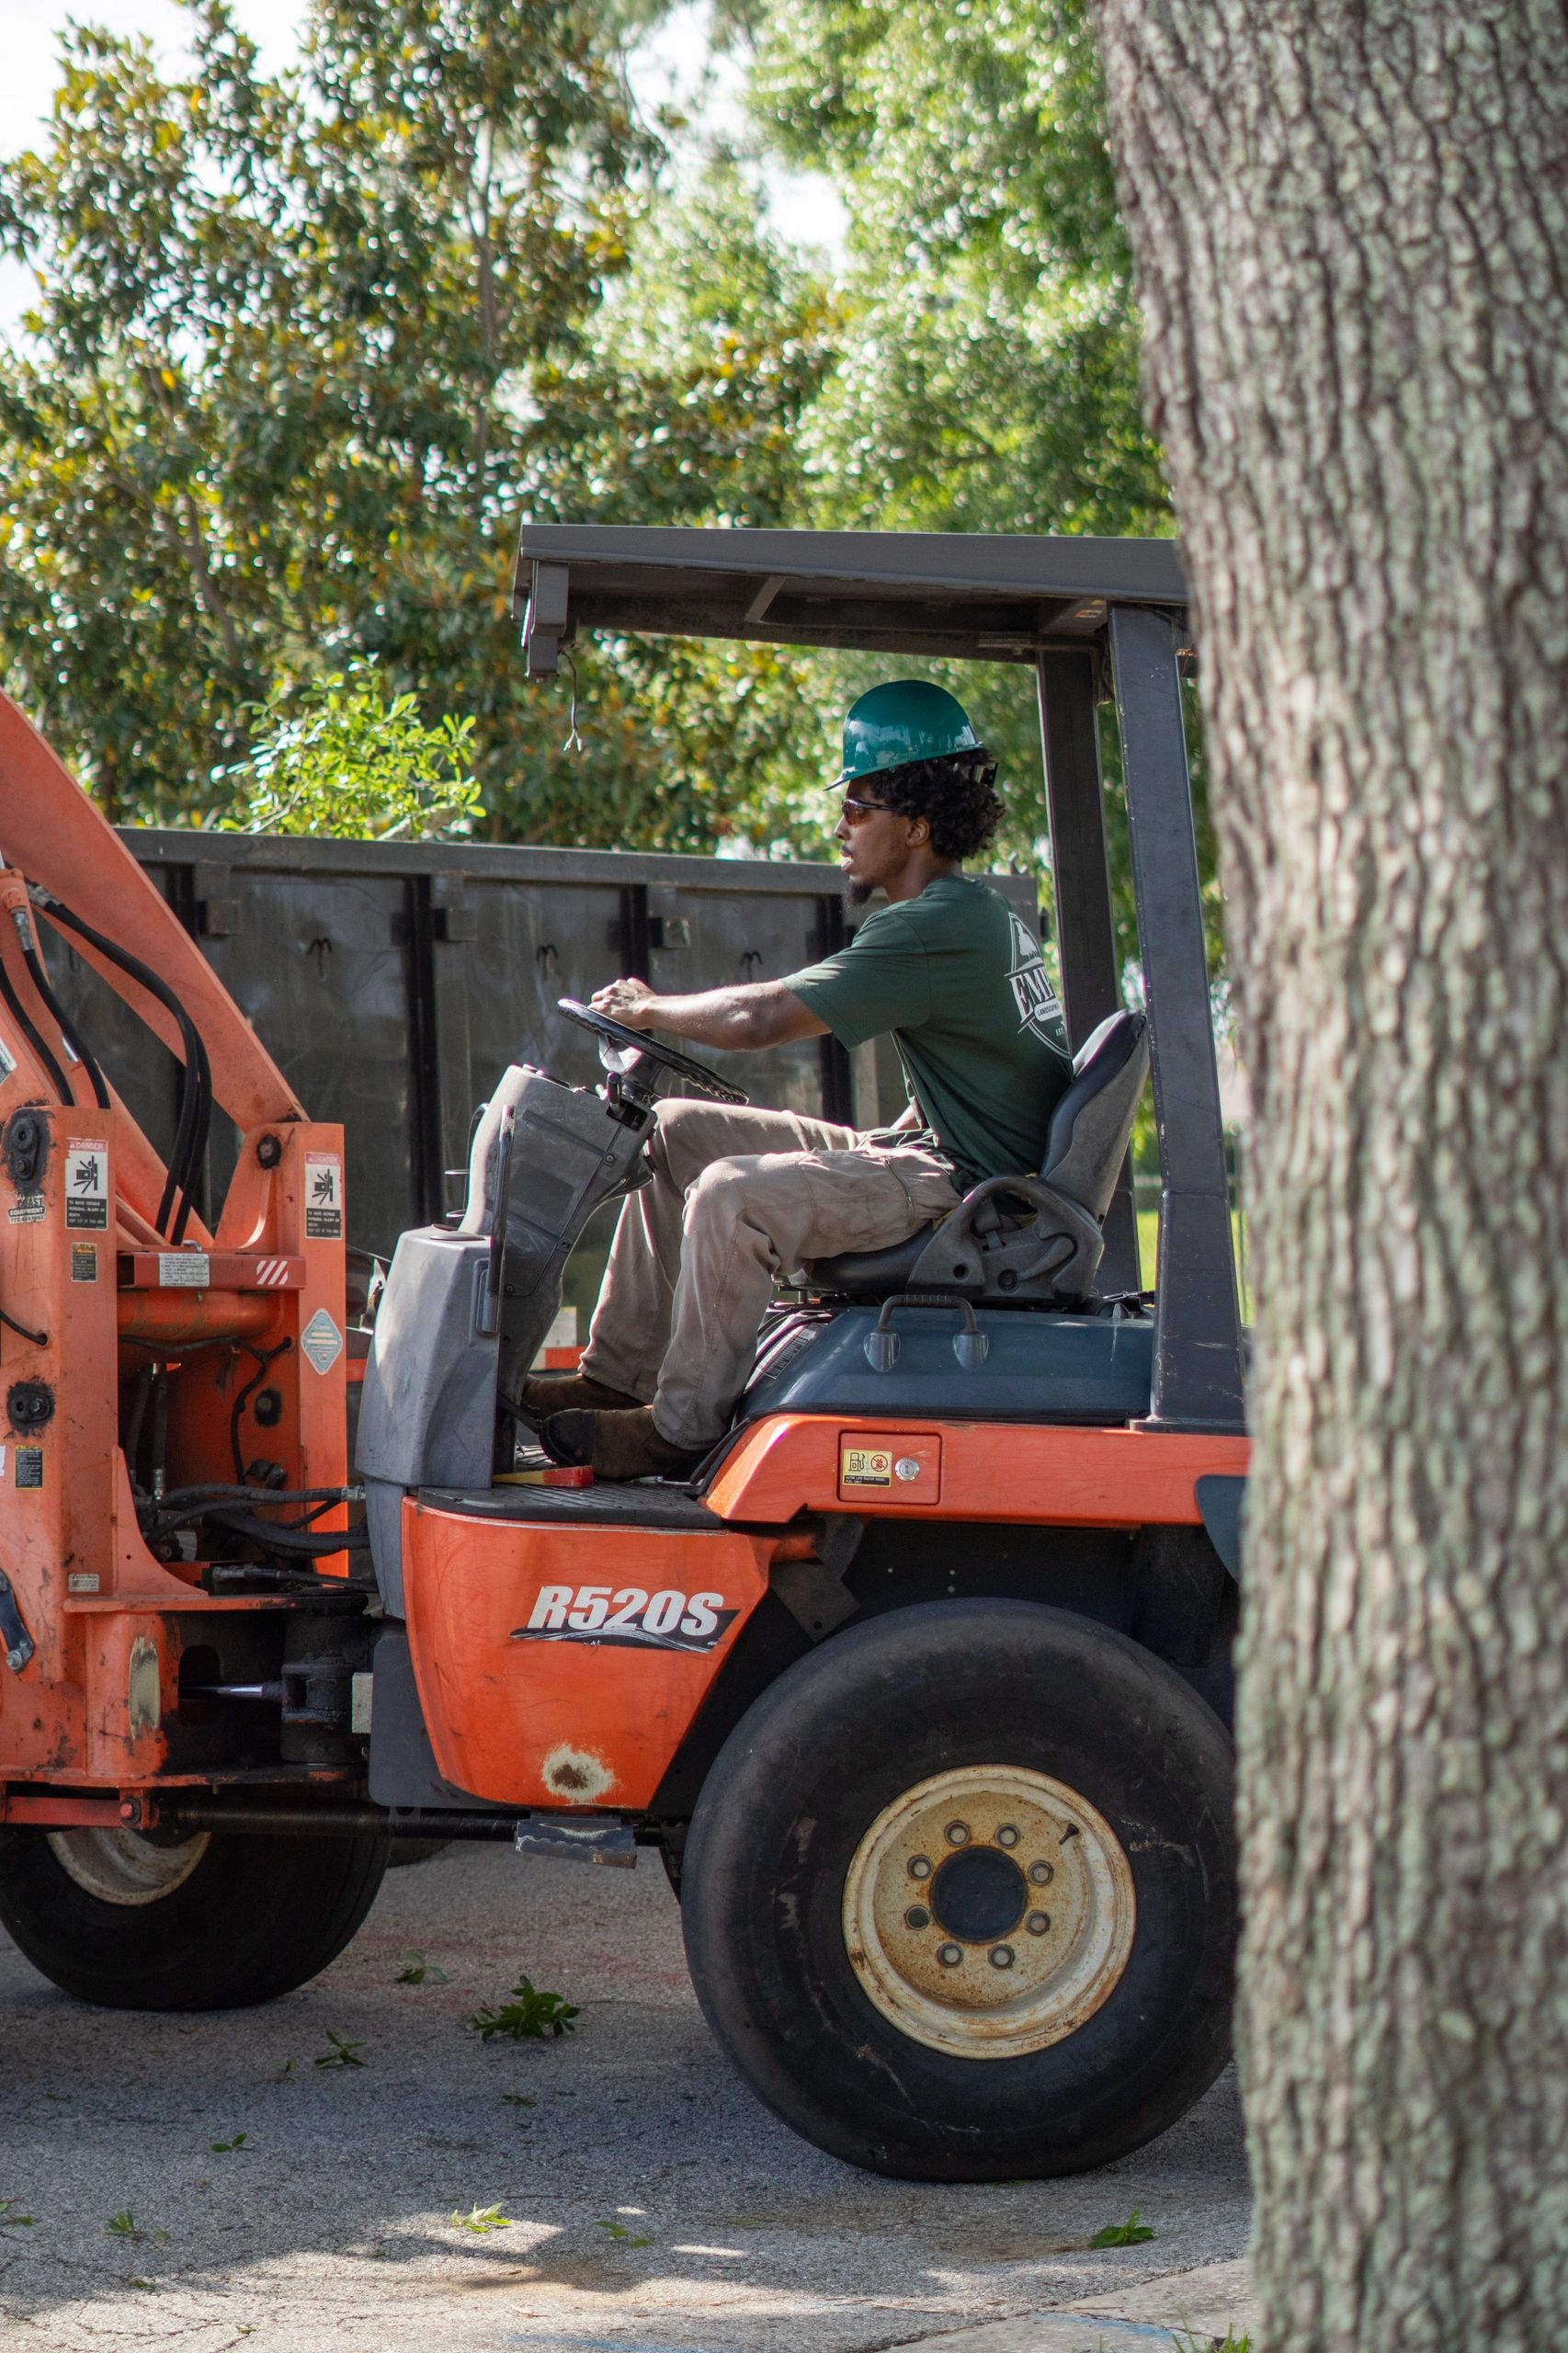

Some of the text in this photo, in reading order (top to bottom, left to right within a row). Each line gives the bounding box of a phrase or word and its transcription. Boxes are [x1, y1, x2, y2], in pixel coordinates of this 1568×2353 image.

[75, 1141, 104, 1151] DANGER
[10, 1207, 43, 1216] EQUIPMENT
[527, 1586, 724, 1636] R520S
